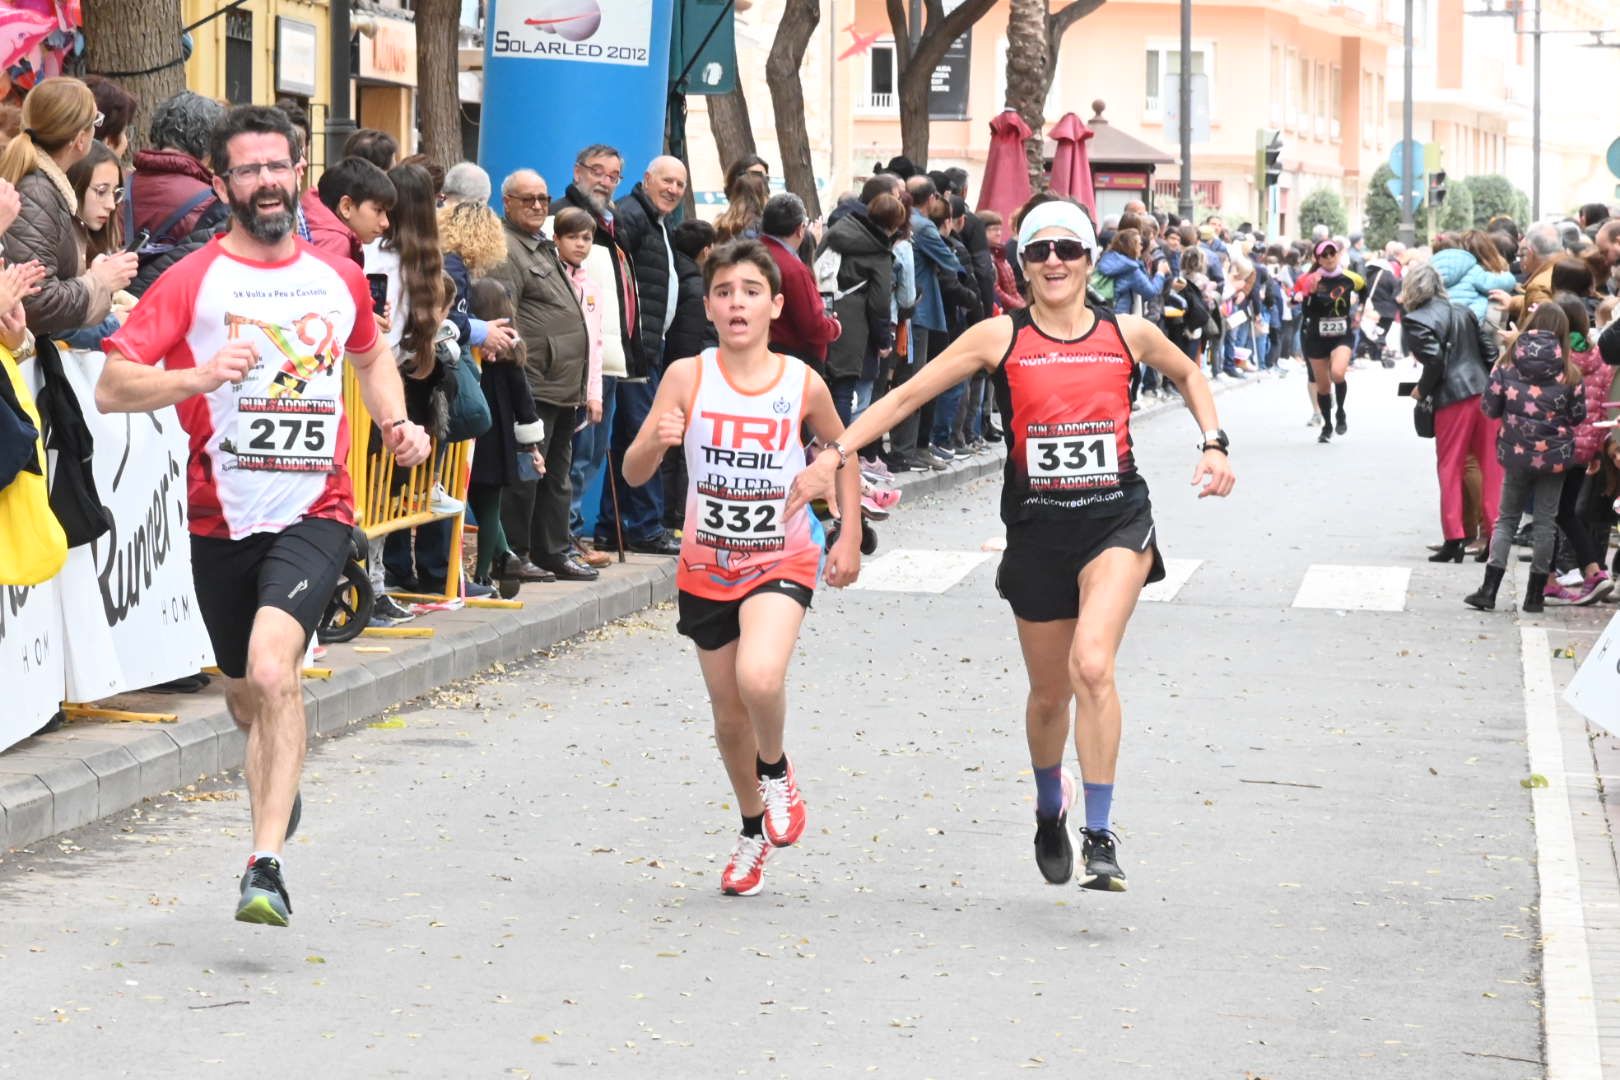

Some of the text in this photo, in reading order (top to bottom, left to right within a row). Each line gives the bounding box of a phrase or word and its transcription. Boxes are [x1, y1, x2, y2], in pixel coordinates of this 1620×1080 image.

[495, 31, 646, 60] SOLARLED 2012
[1322, 323, 1344, 331] 223
[1019, 351, 1124, 367] RUN ADDICTION
[240, 398, 335, 412] RUN ADDICTION
[249, 418, 325, 451] 275
[701, 410, 791, 451] TRI
[1028, 420, 1114, 434] RUN ADDICTION
[238, 456, 333, 471] RUN ADDICTION
[1037, 439, 1106, 471] 331
[1030, 474, 1119, 489] RUN ADDICTION
[698, 482, 784, 499] RUN ADDICTION
[704, 500, 776, 533] 332
[696, 532, 784, 550] RUN ADDICTION
[161, 595, 191, 626] HOM
